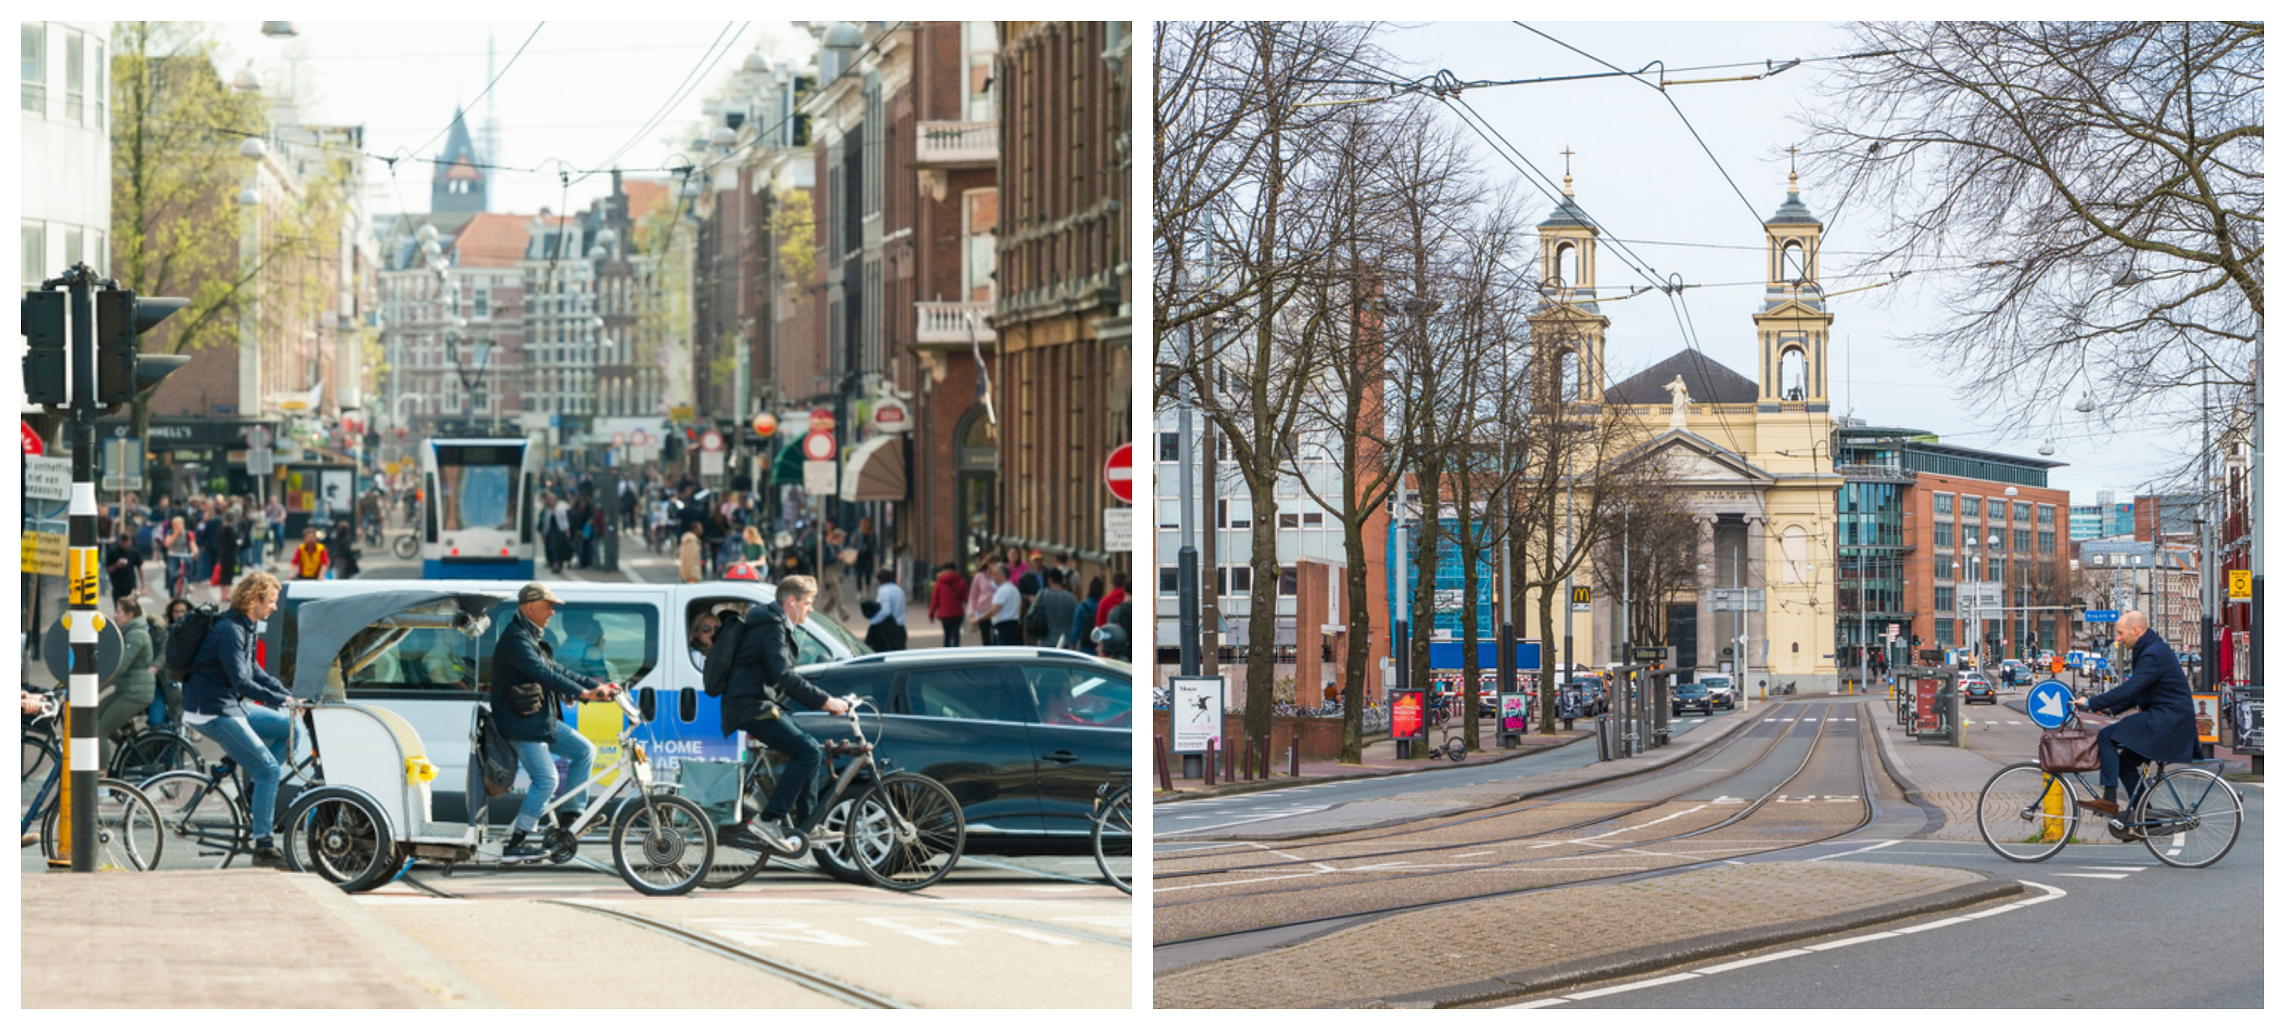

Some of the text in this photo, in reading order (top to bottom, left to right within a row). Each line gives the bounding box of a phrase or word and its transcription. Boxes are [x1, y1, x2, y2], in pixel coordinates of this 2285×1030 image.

[34, 462, 72, 477] ontheffing
[28, 472, 59, 484] niet van
[1179, 723, 1216, 733] Banksy
[599, 746, 617, 755] SIM
[653, 740, 703, 754] HOME
